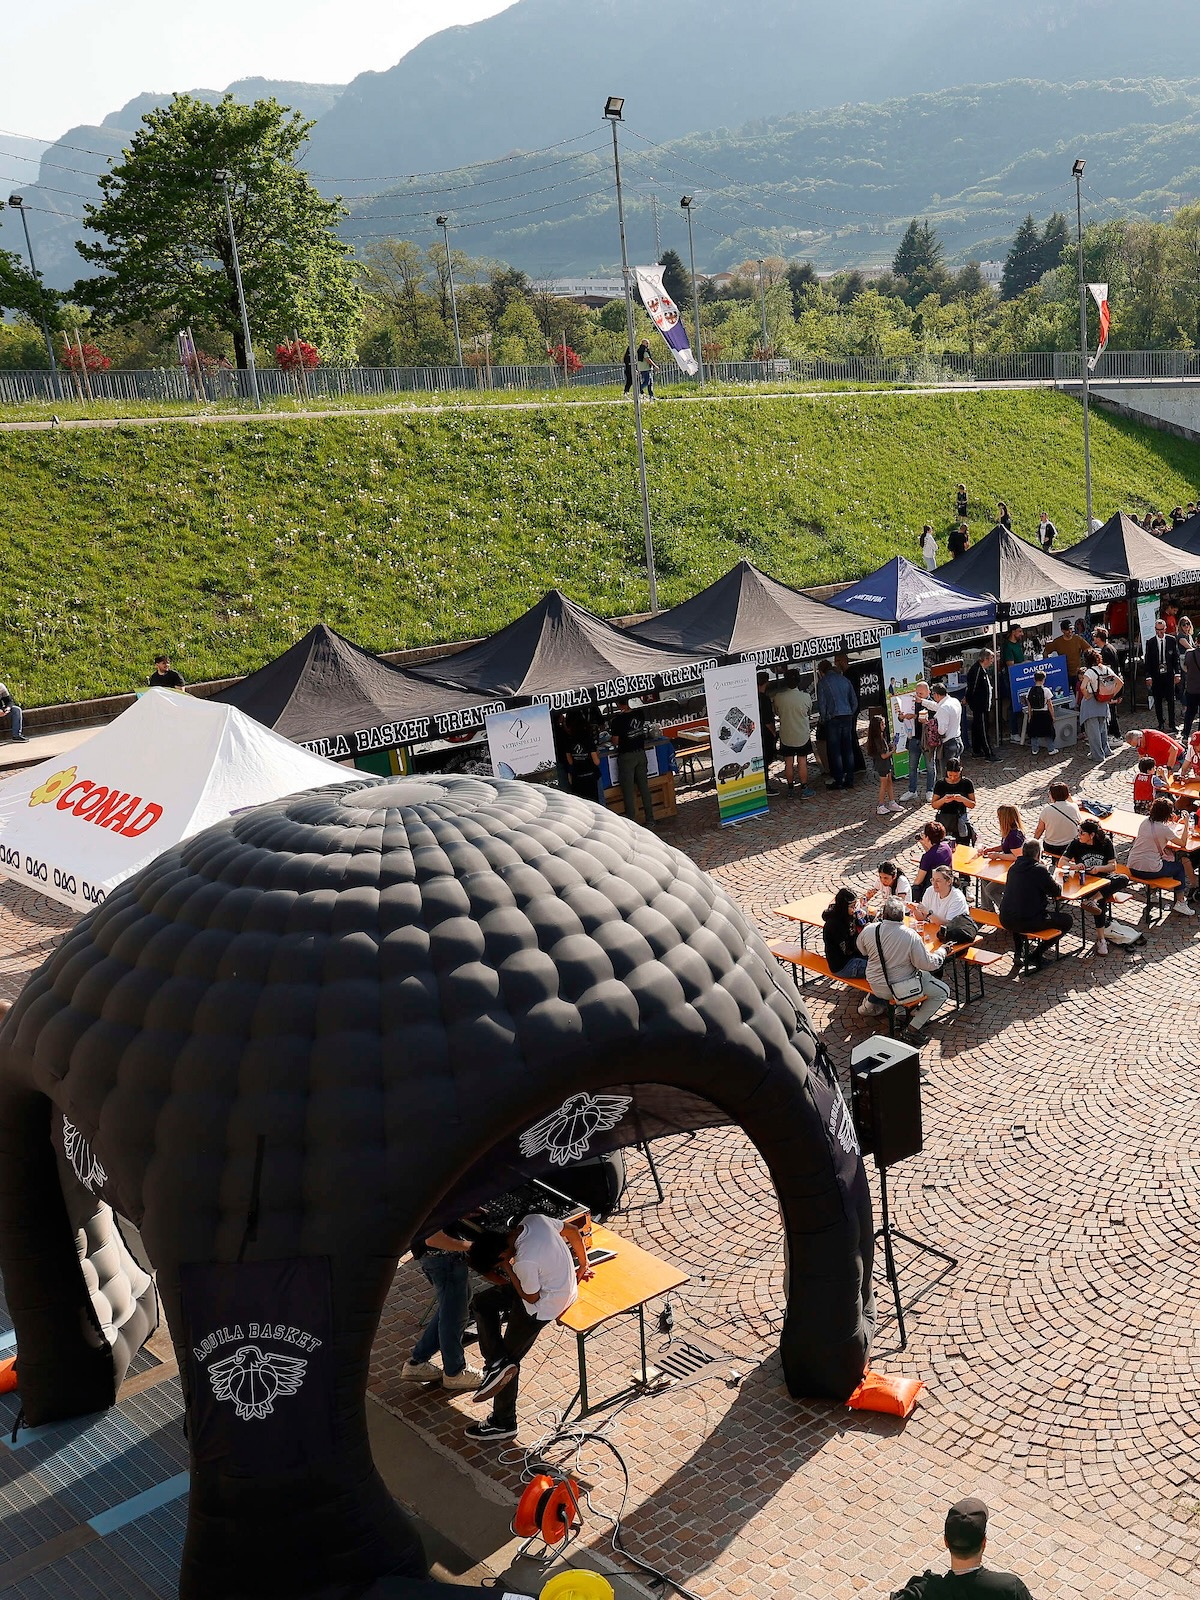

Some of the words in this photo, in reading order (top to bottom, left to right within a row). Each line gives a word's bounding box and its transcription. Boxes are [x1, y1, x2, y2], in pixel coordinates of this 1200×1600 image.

[1137, 577, 1169, 593] AQUILA
[1170, 569, 1200, 587] BASKET
[1009, 597, 1048, 616] AQUILA
[1050, 589, 1088, 607] BASKET
[1089, 582, 1127, 601] TRENTO
[792, 634, 842, 660] BASKET
[845, 624, 894, 649] TRENTO
[886, 646, 919, 659] melixa
[1023, 662, 1054, 675] DAKOTA
[594, 673, 657, 701] BASKET
[354, 716, 430, 751] BASKET
[56, 780, 164, 838] CONAD
[193, 1324, 244, 1361] AQUILA
[249, 1323, 322, 1352] BASKET
